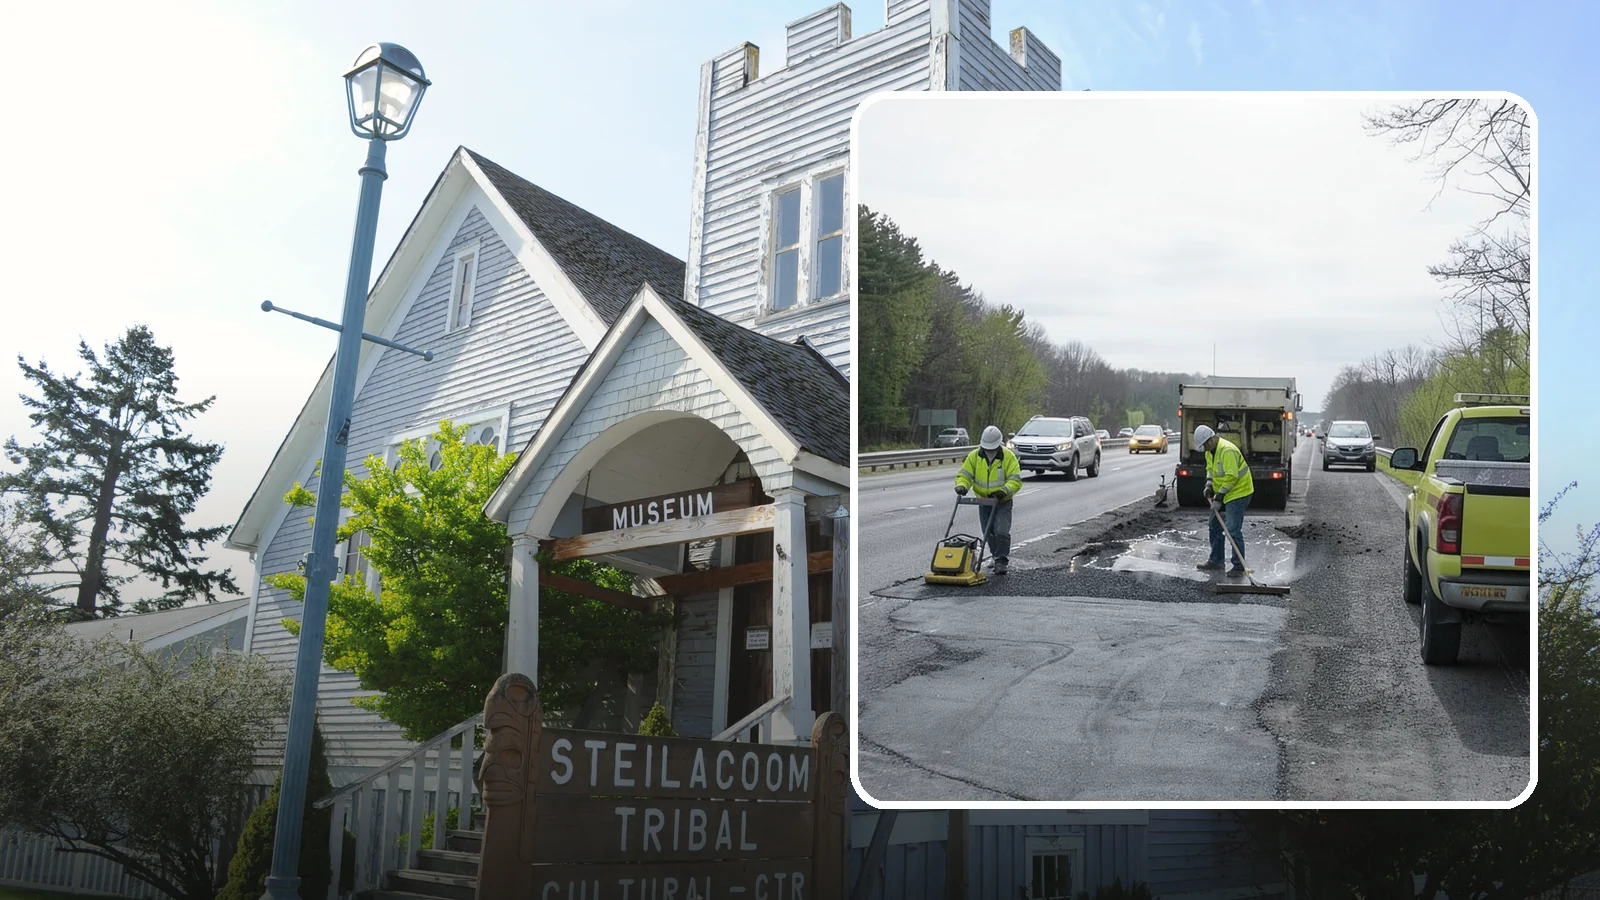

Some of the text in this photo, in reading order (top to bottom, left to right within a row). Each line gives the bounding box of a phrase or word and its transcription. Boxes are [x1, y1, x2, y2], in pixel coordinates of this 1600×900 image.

[612, 492, 713, 530] MUSEUM
[550, 738, 809, 793] STEILACOOM
[614, 806, 758, 852] TRIBAL
